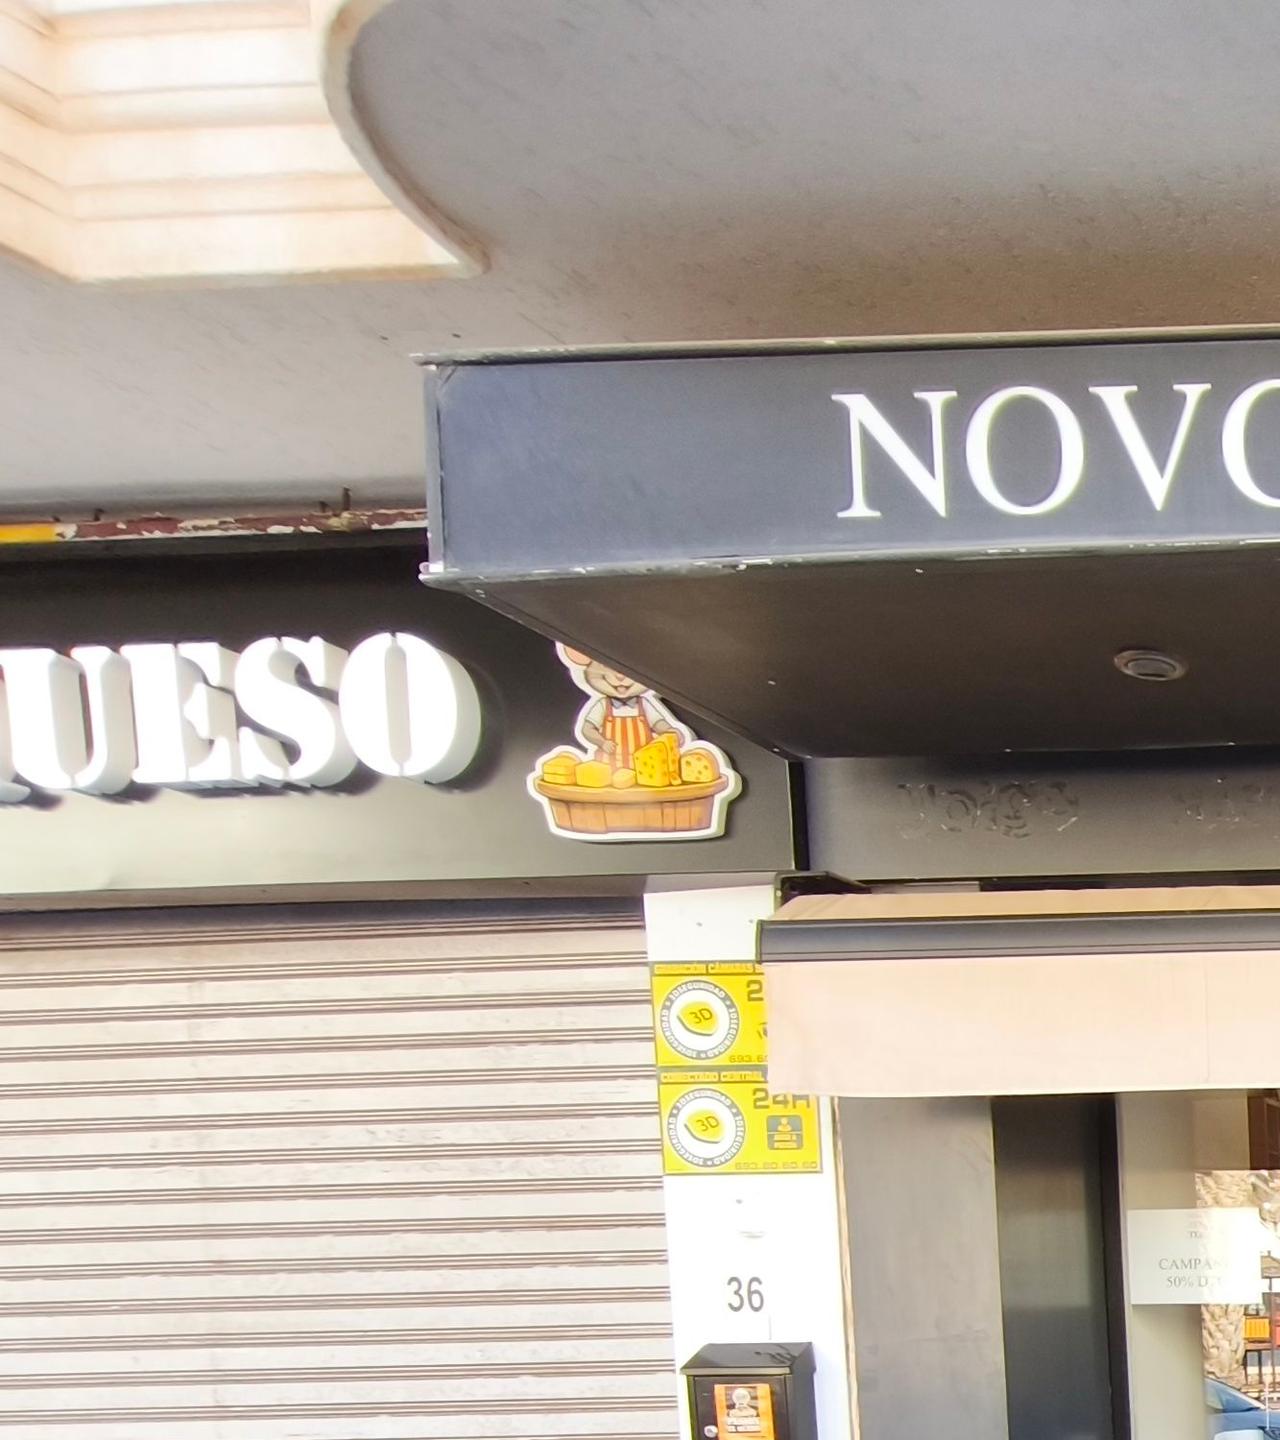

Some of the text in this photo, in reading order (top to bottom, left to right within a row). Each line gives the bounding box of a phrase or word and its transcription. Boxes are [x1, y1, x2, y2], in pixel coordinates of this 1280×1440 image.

[0, 631, 482, 802] UESO
[688, 1008, 713, 1024] 3D
[695, 1115, 720, 1132] 3D
[727, 1275, 764, 1313] 36
